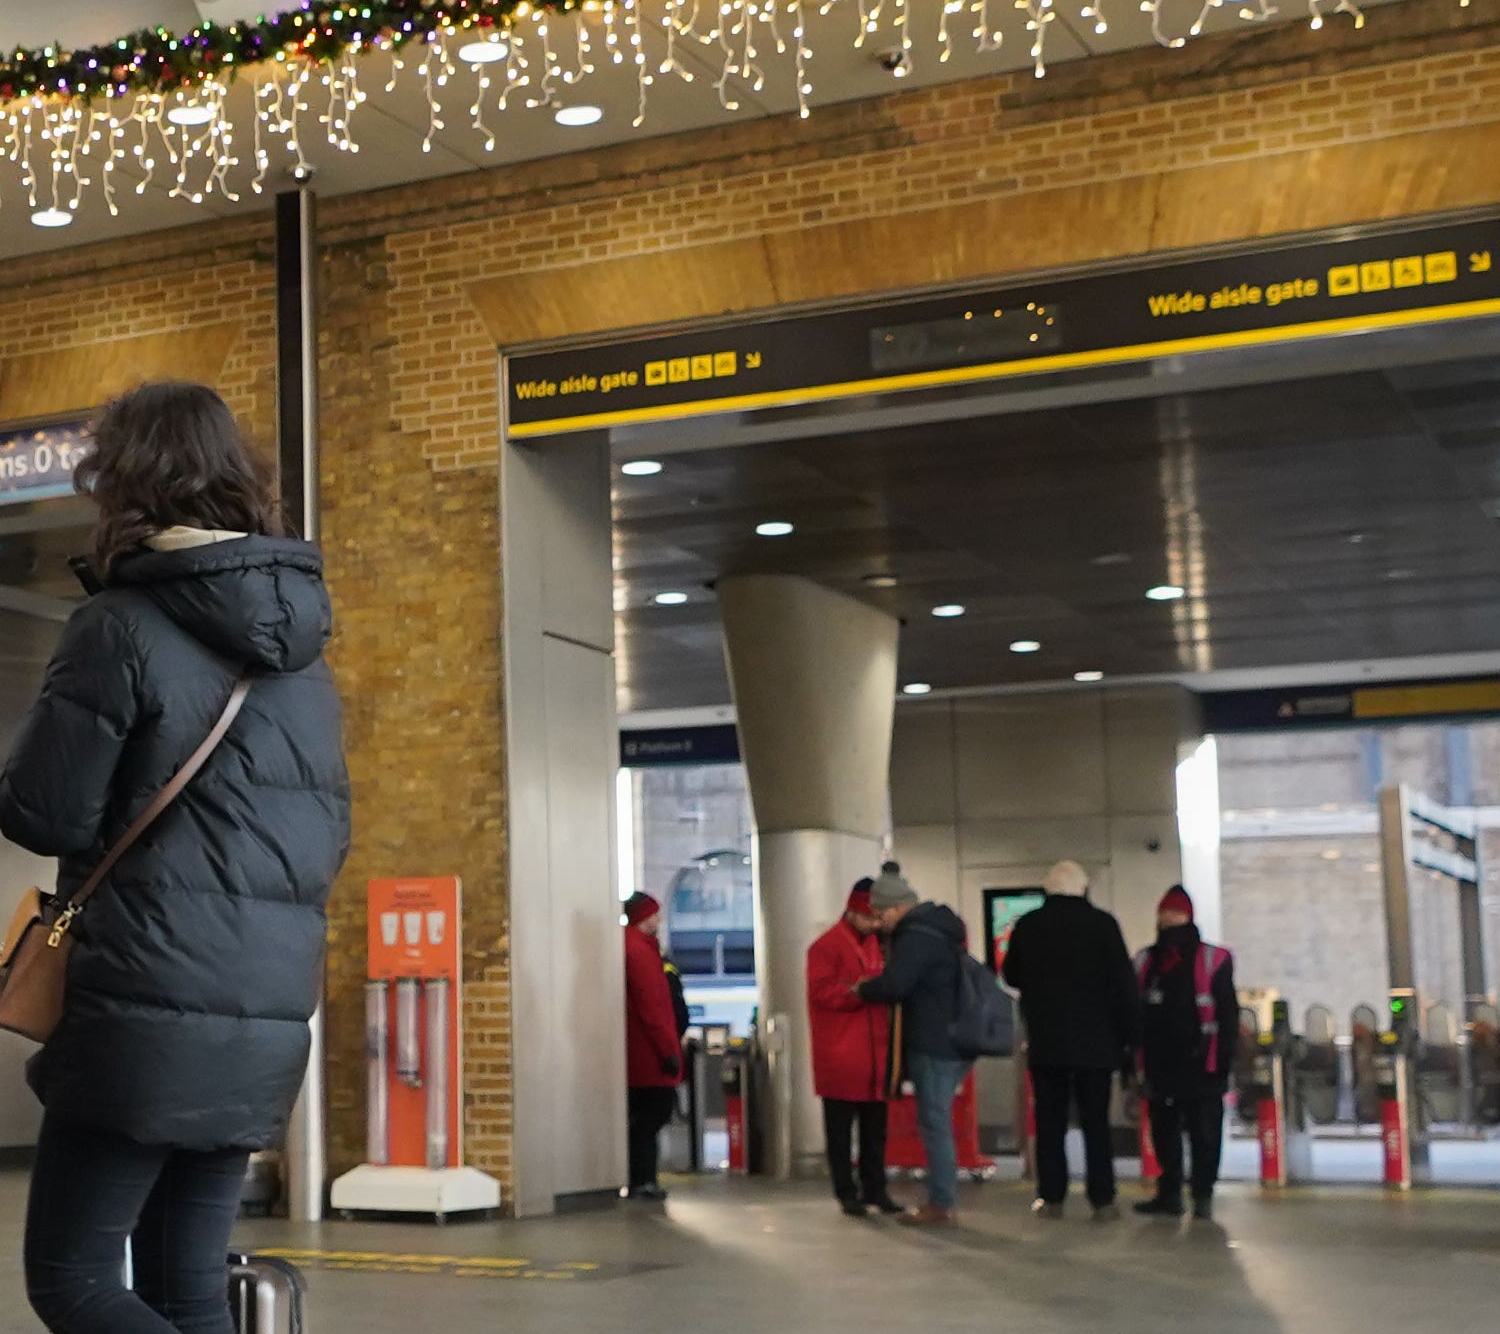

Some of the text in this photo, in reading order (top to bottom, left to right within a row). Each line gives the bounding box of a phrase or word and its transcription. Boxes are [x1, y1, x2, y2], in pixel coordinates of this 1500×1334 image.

[1149, 278, 1319, 316] Wide aisle gate
[516, 371, 638, 400] Wide aisle gate
[34, 446, 53, 474] 0
